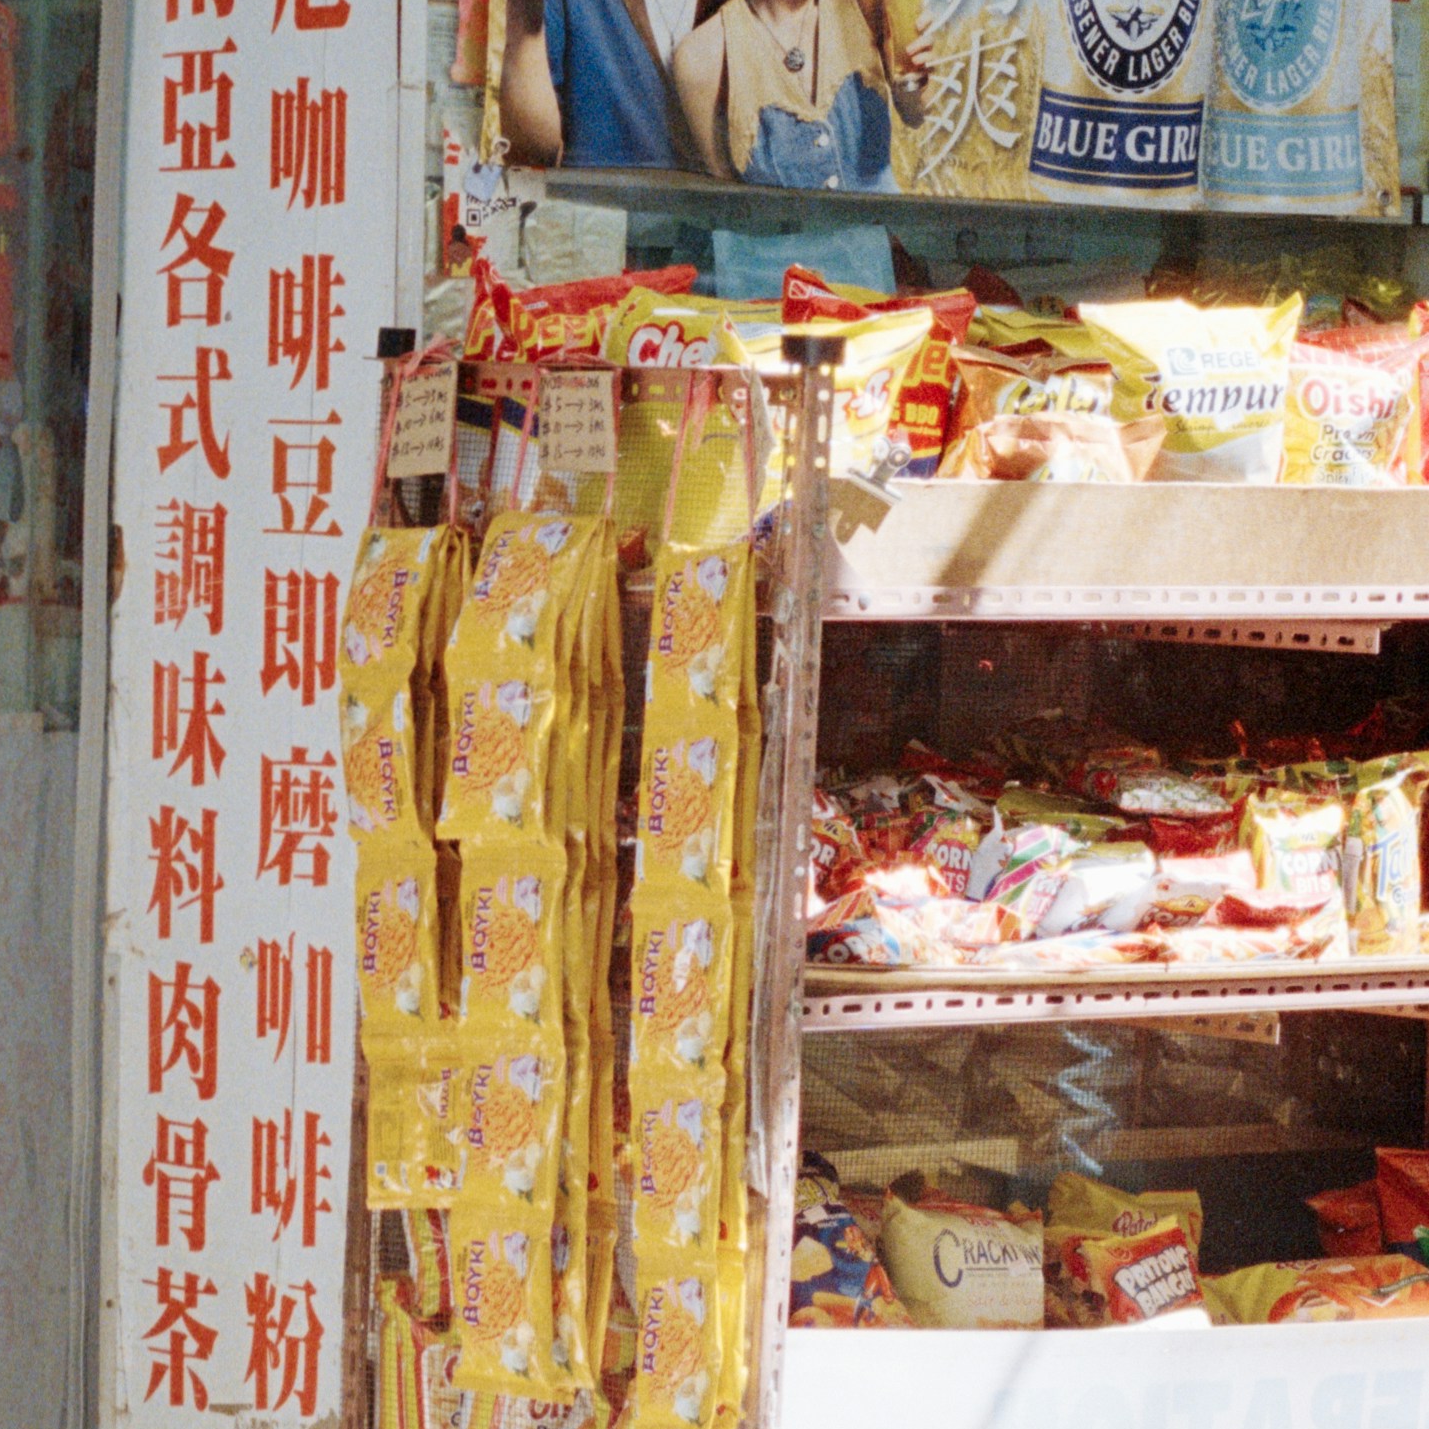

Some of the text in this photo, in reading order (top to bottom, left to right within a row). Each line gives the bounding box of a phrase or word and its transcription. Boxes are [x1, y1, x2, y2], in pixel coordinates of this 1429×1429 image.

[1127, 25, 1187, 83] LAGER
[1037, 111, 1198, 164] BLUE GIRL
[1275, 134, 1358, 174] GIRL
[1143, 373, 1285, 415] Tempur
[1303, 378, 1398, 420] Oishi
[474, 529, 514, 601] BOYKI
[385, 568, 409, 649] BOYKI
[657, 570, 684, 655] BOYKI
[452, 690, 477, 778] BOYKI
[379, 738, 398, 822] BOYKI
[648, 748, 670, 836] BOYKI
[362, 890, 382, 975] BOYKI
[471, 885, 493, 973] BOYKI
[639, 929, 664, 1017] BOYKI
[467, 1063, 494, 1149] BOYKI
[639, 1108, 660, 1196] BOYKI
[461, 1239, 487, 1326] BOYKI
[1114, 1244, 1188, 1299] PRITONG
[643, 1285, 665, 1374] BOYKI
